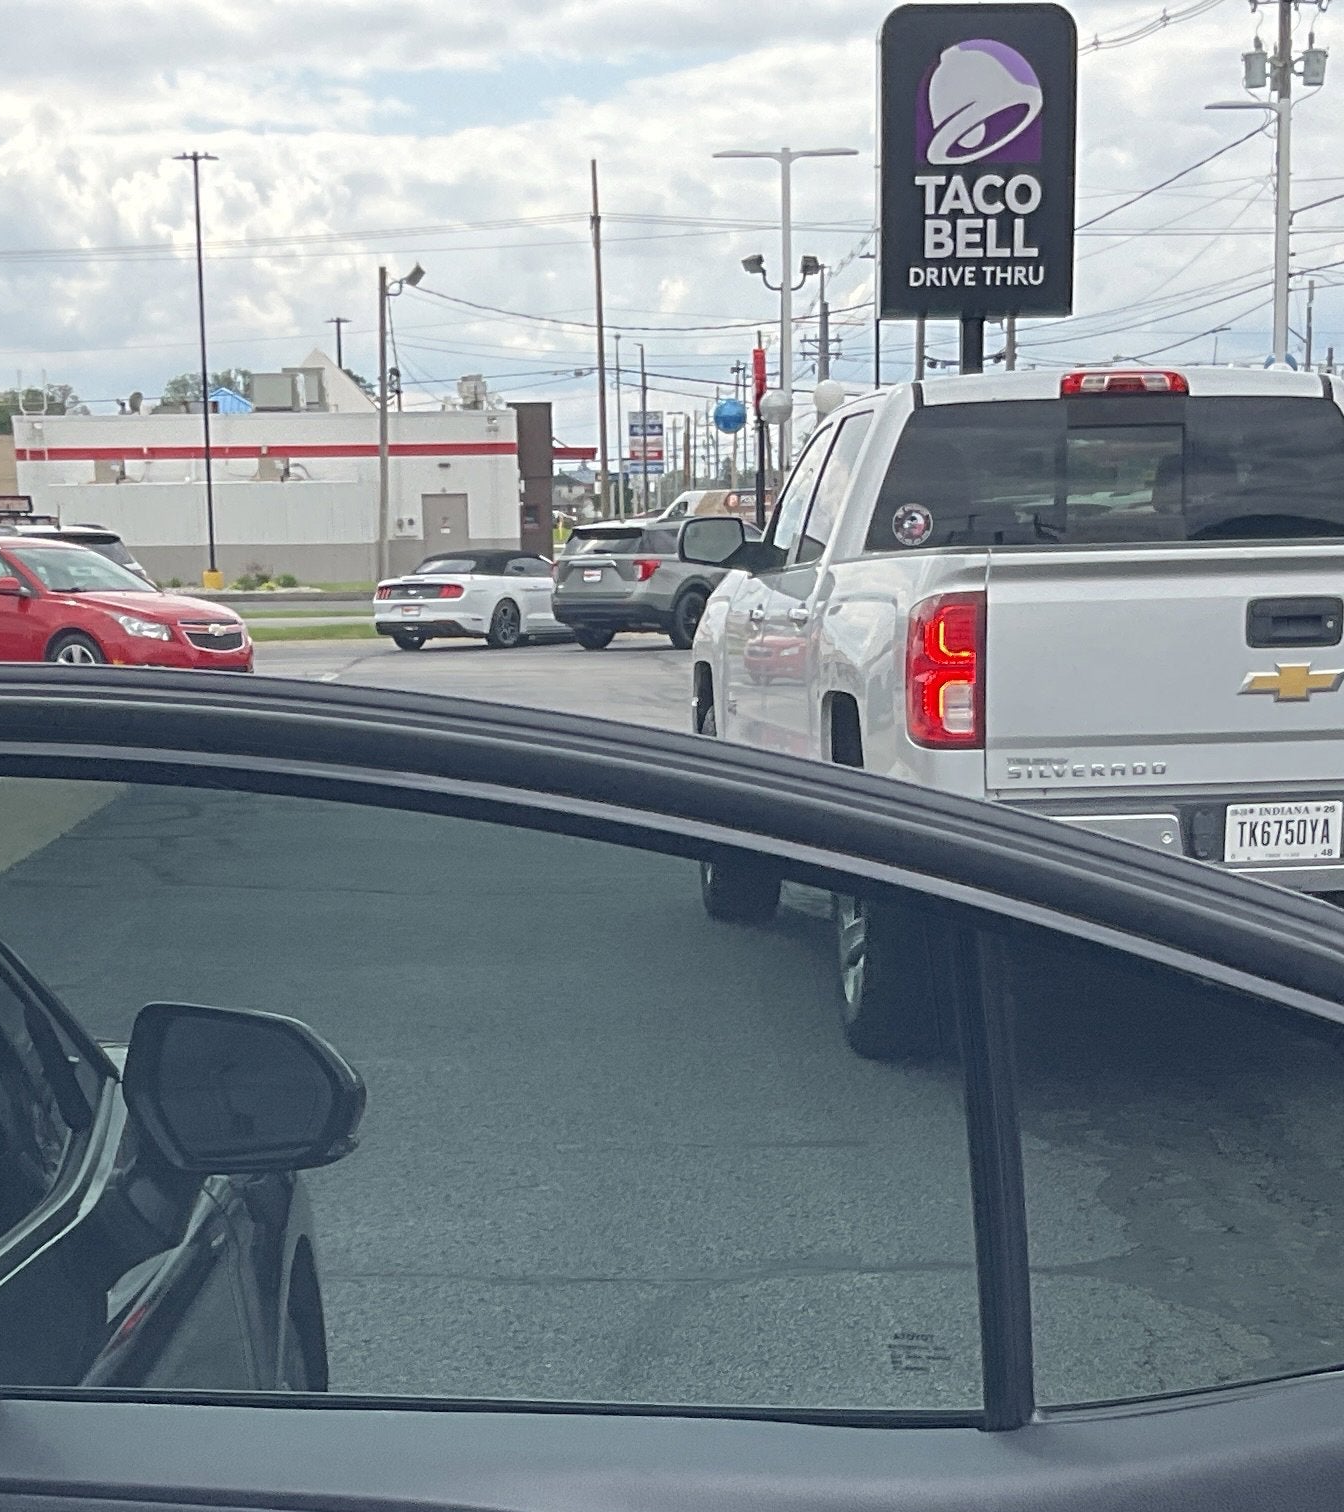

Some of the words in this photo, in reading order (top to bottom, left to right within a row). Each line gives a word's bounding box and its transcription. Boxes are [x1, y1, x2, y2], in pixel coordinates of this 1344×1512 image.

[914, 174, 1042, 215] TACO
[923, 218, 1039, 259] BELL
[908, 266, 976, 287] DRIVE
[982, 265, 1045, 286] THRU
[1007, 762, 1167, 779] SILVERADO
[1258, 805, 1311, 816] INDIANA
[1320, 848, 1334, 857] 48
